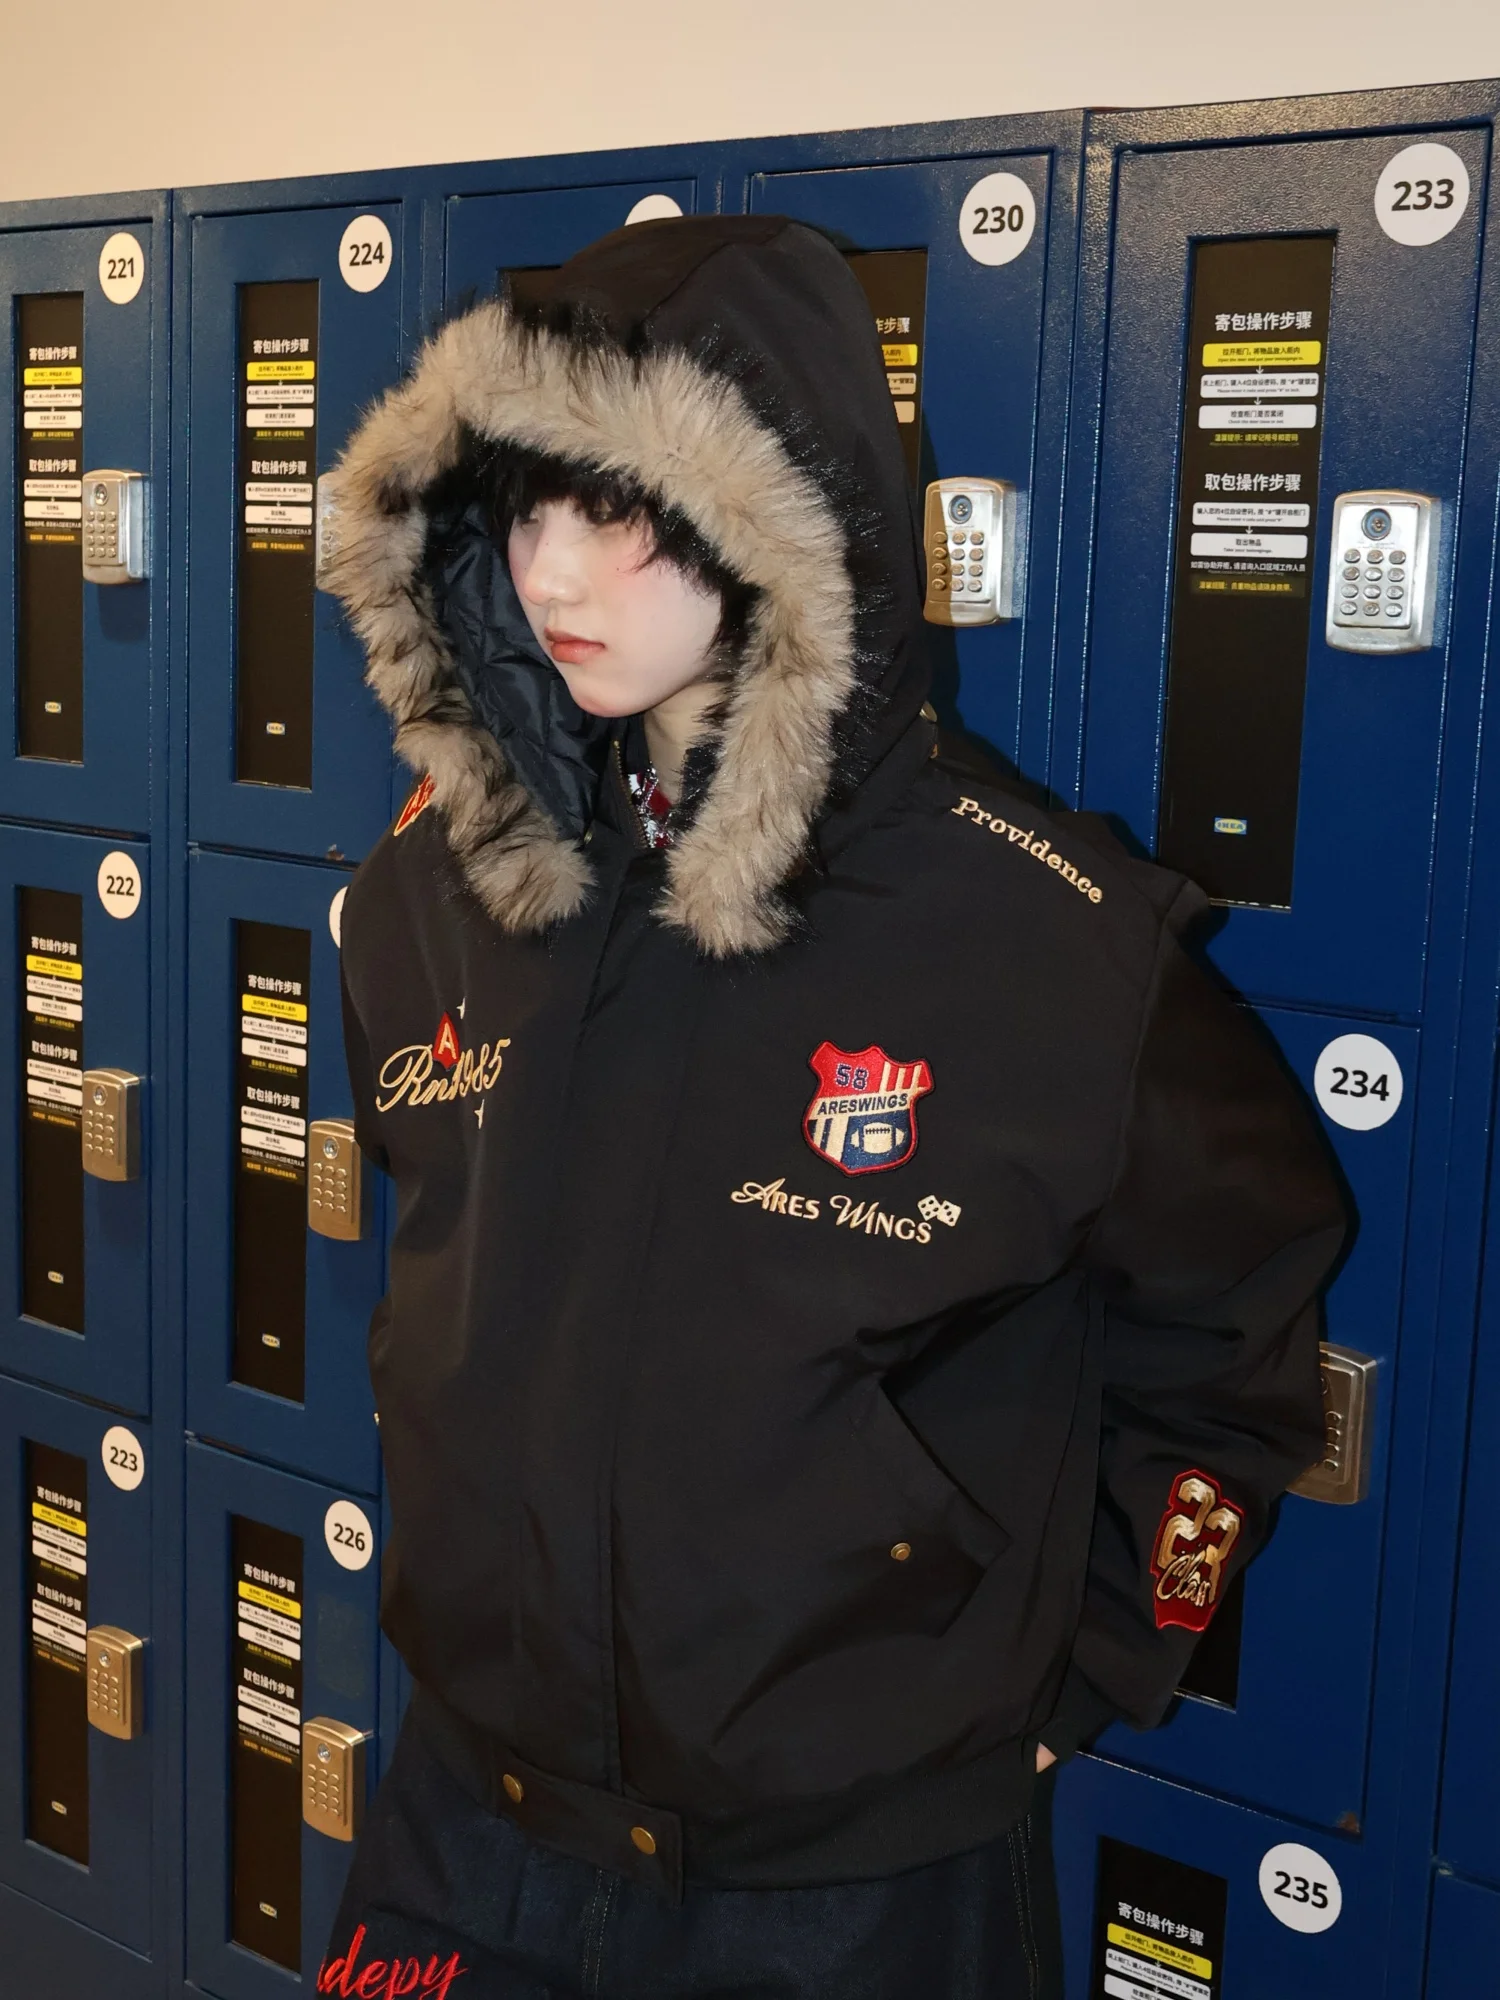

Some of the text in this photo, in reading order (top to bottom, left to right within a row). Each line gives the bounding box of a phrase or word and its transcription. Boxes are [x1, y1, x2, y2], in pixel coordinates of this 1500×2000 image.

[1391, 178, 1455, 212] 233
[972, 204, 1024, 235] 230
[107, 257, 135, 280] 221
[349, 241, 385, 267] 224
[1214, 310, 1313, 332] 寄包操作步骤
[1204, 473, 1302, 492] 取包操作步骤
[951, 796, 1103, 904] Providence
[106, 875, 135, 897] 222
[437, 1022, 457, 1060] A
[835, 1063, 869, 1091] 58
[1330, 1066, 1390, 1102] 234
[817, 1092, 909, 1116] ARESWINGS
[109, 1446, 138, 1472] 223
[333, 1522, 366, 1552] 226
[1273, 1870, 1329, 1909] 235
[1117, 1901, 1204, 1946] 寄包操作步骤
